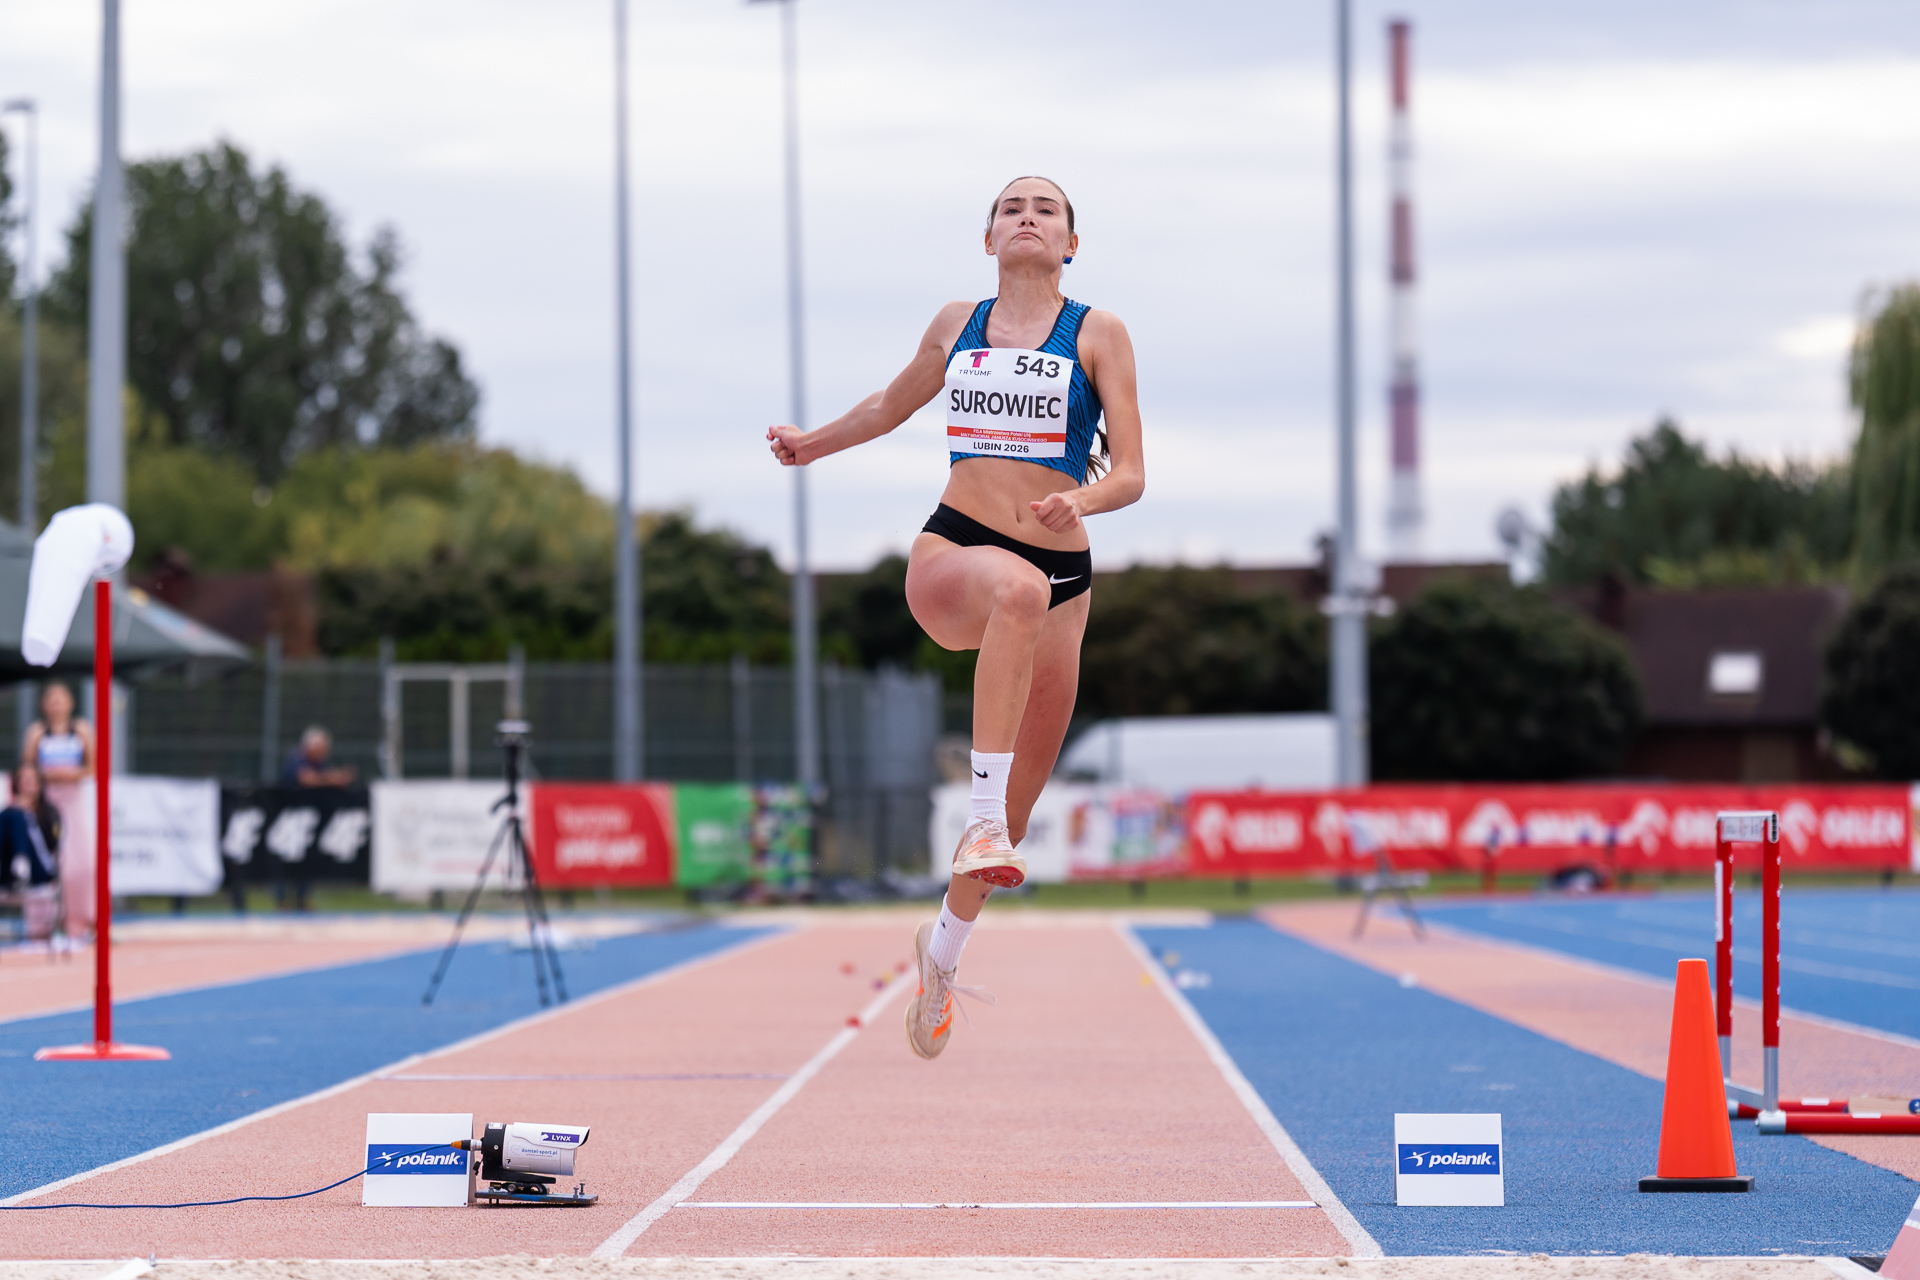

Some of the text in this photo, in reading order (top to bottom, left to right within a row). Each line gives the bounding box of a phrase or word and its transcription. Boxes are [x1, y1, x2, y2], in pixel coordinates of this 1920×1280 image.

[959, 369, 992, 377] TRYUMF
[1014, 355, 1060, 378] 543
[951, 389, 1062, 419] SUROWIEC
[973, 442, 1029, 454] LUBIN 2026
[551, 1134, 571, 1142] LYNX
[521, 1148, 558, 1156] domtel-sport.pl
[397, 1151, 459, 1168] polanik
[1428, 1152, 1493, 1168] polanik
